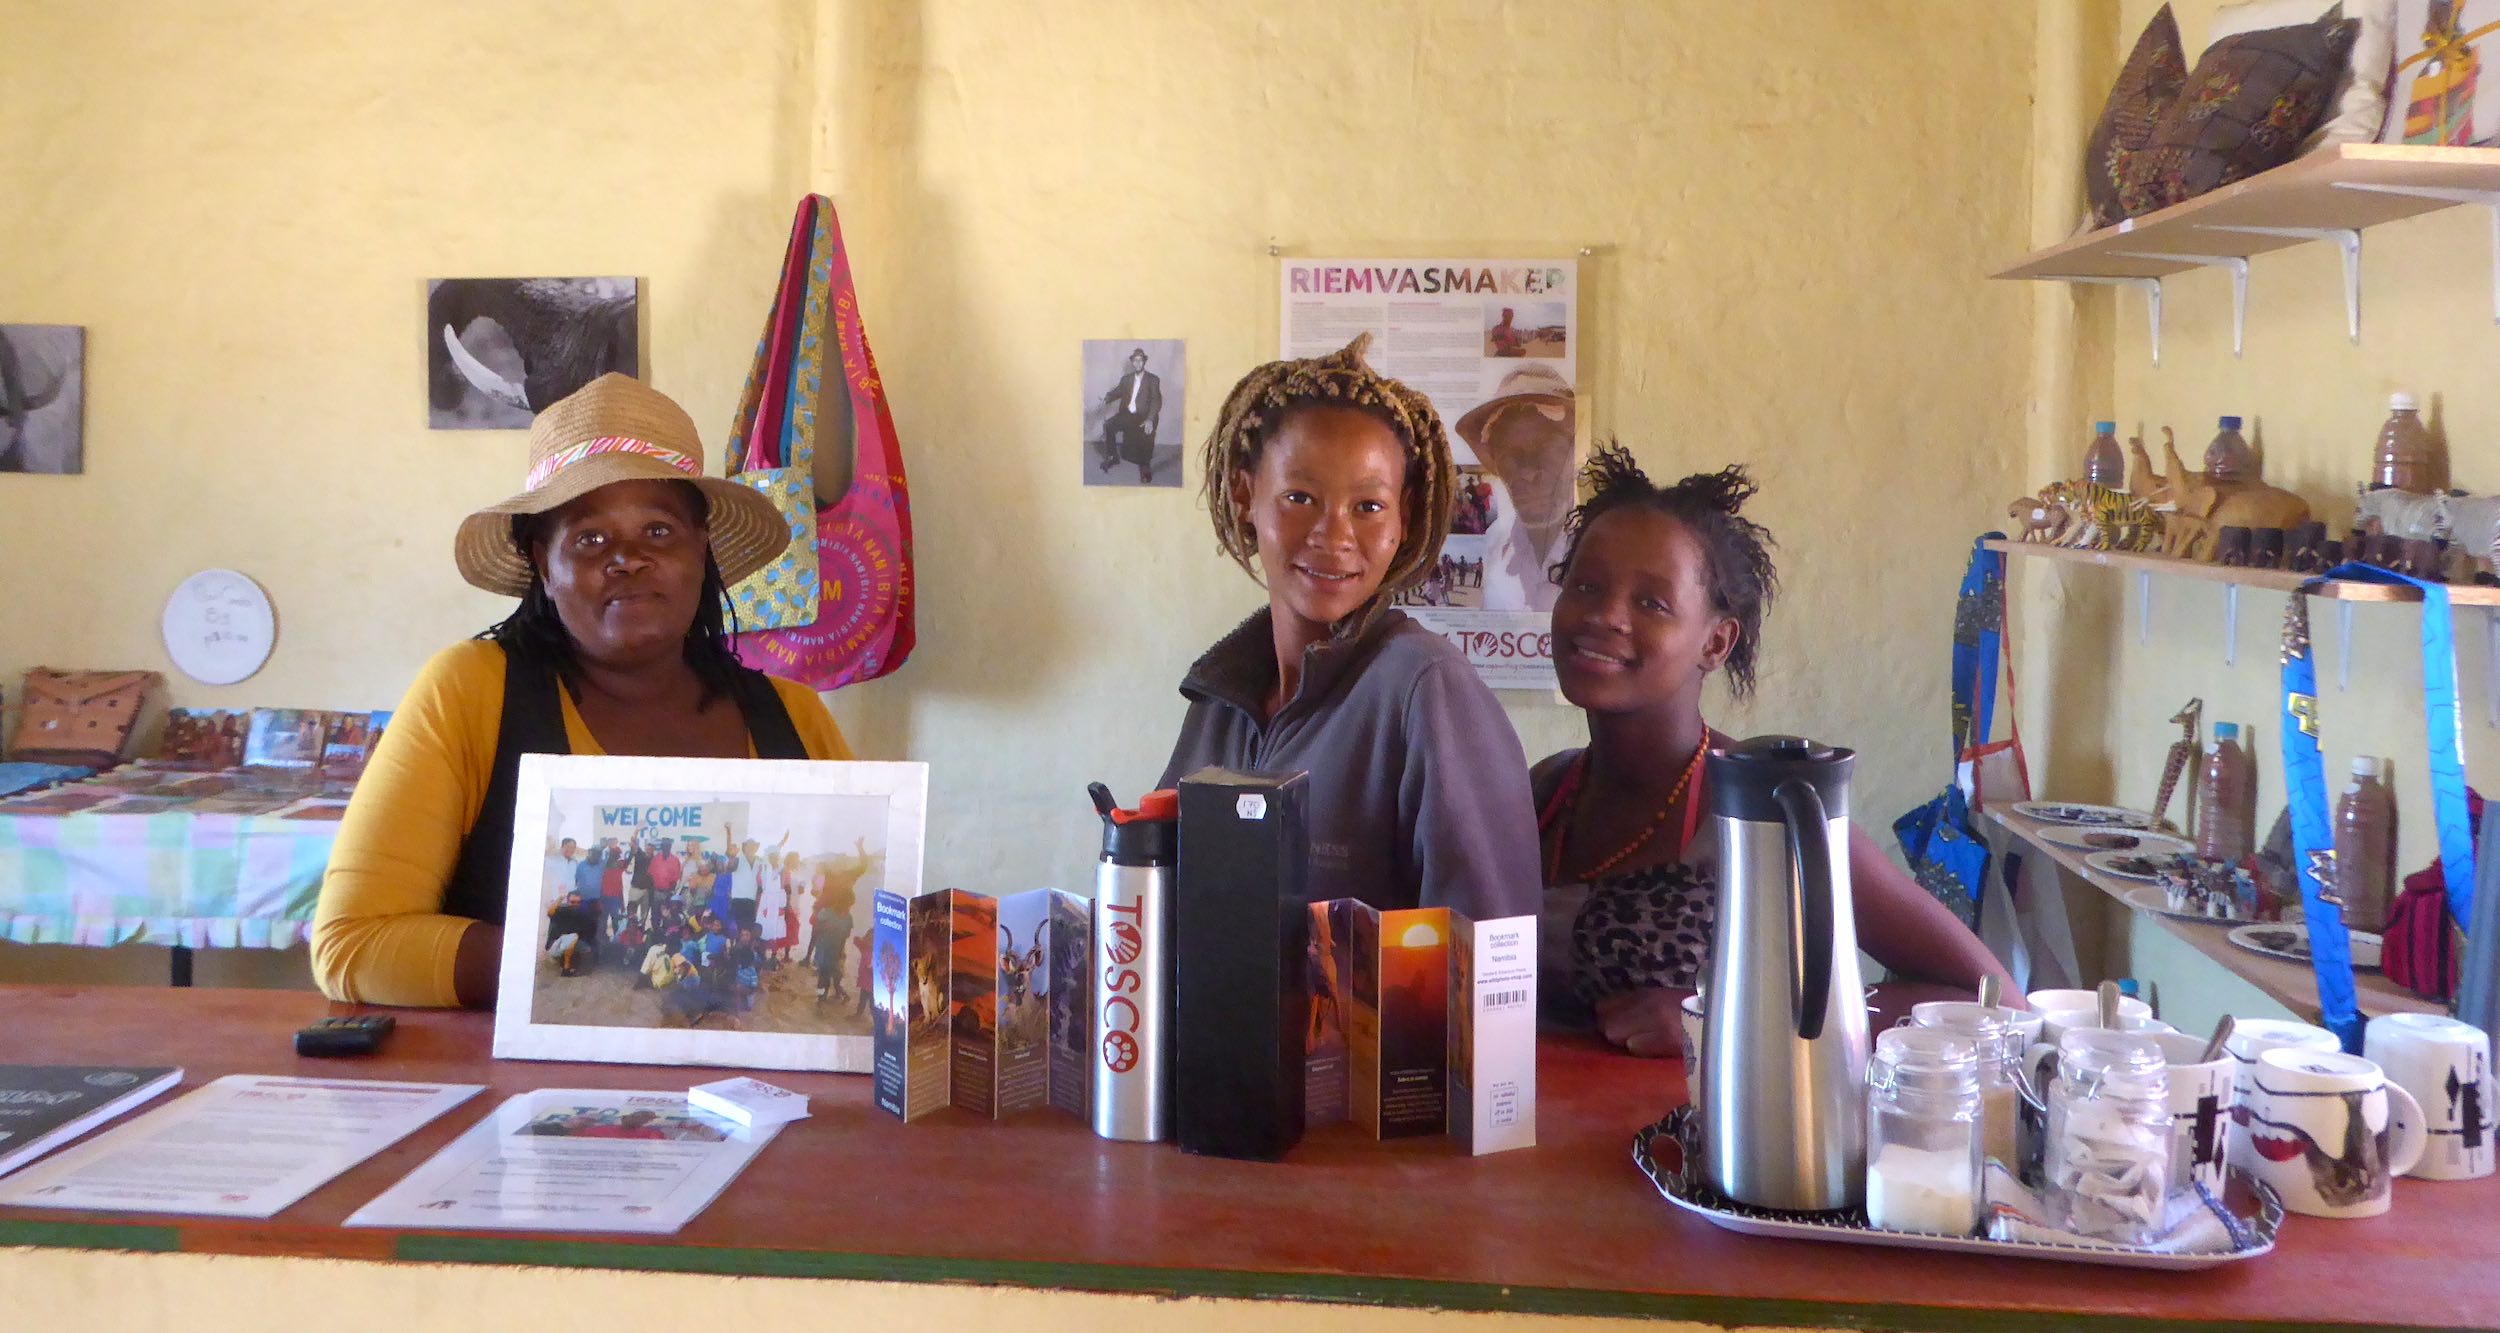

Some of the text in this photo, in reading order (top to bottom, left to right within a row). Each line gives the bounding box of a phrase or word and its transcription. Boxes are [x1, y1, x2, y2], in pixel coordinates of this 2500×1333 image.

[1289, 266, 1567, 295] RIEMVASMAKER
[877, 901, 907, 921] Bookmark
[1489, 932, 1520, 943] Bookmark
